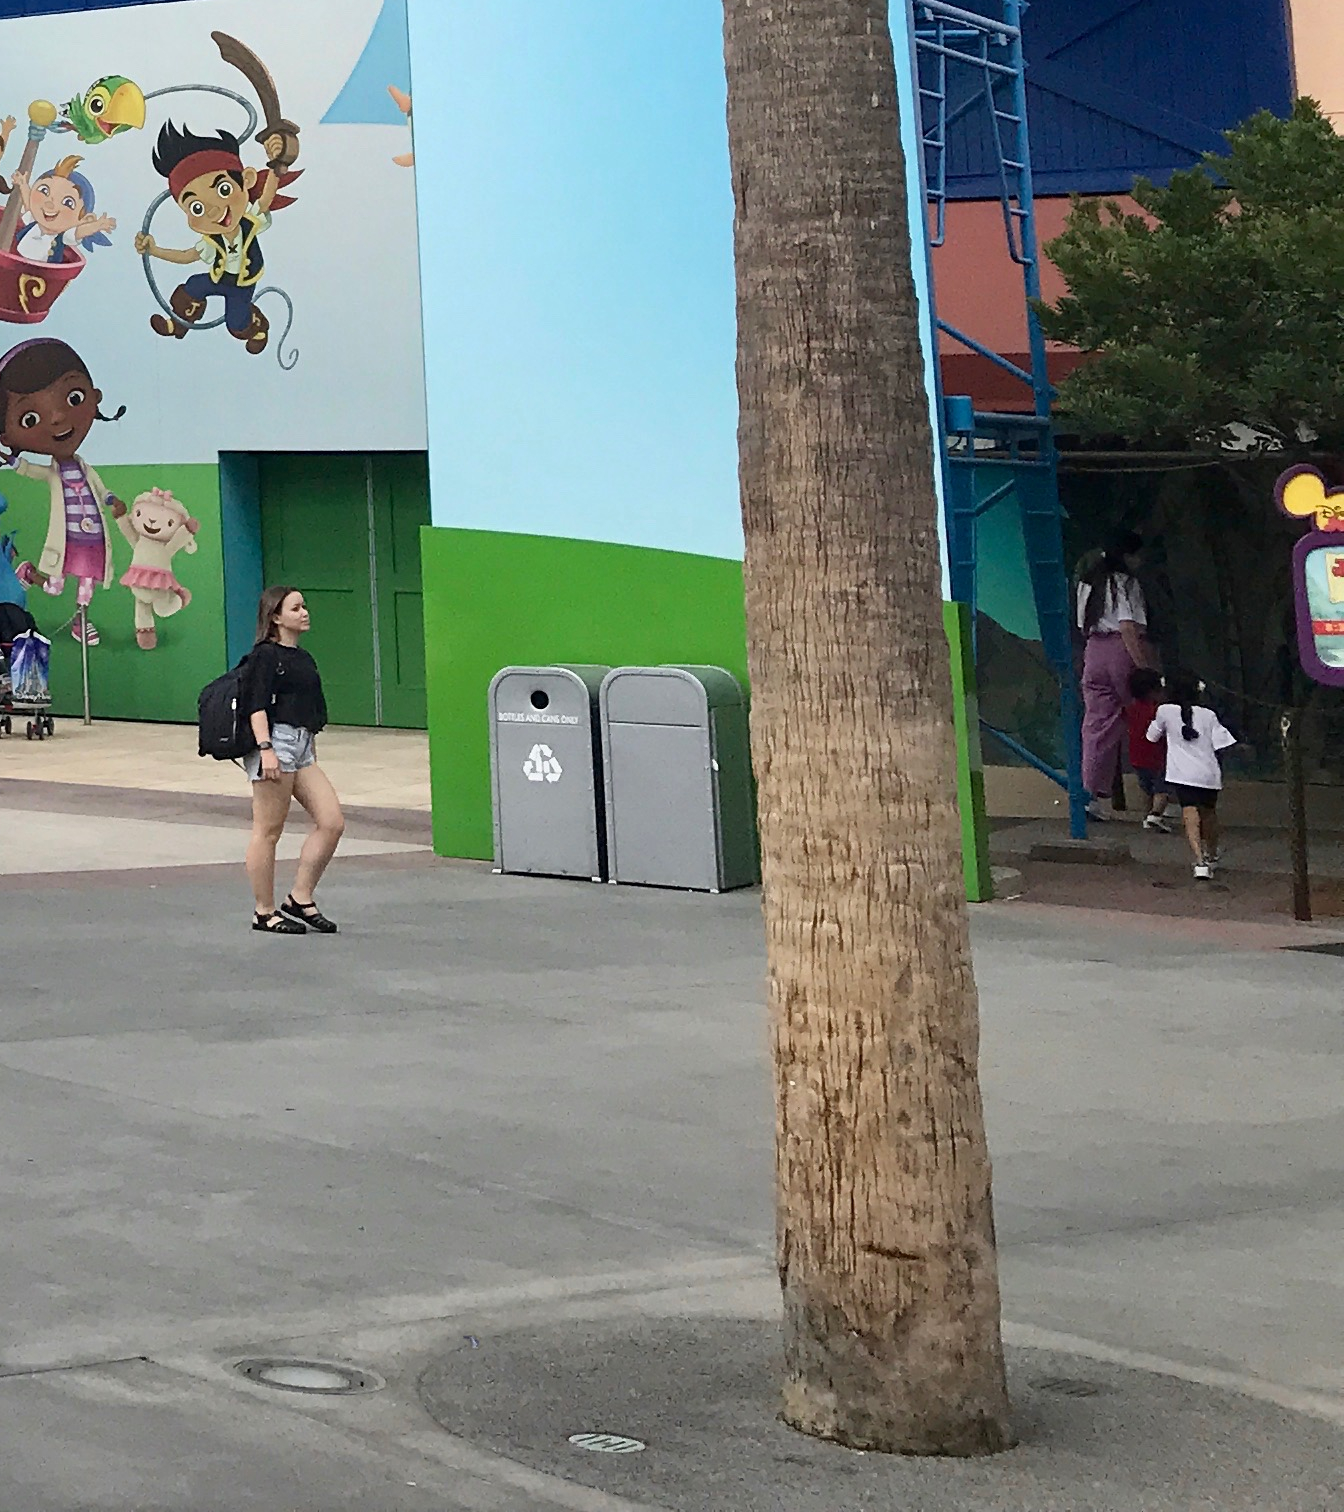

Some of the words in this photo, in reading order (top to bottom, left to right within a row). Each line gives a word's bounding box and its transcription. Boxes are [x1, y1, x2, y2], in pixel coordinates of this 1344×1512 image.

[498, 712, 525, 722] BOTTLES
[525, 714, 541, 723] AND
[541, 714, 560, 724] CANS
[560, 715, 579, 725] ONLY
